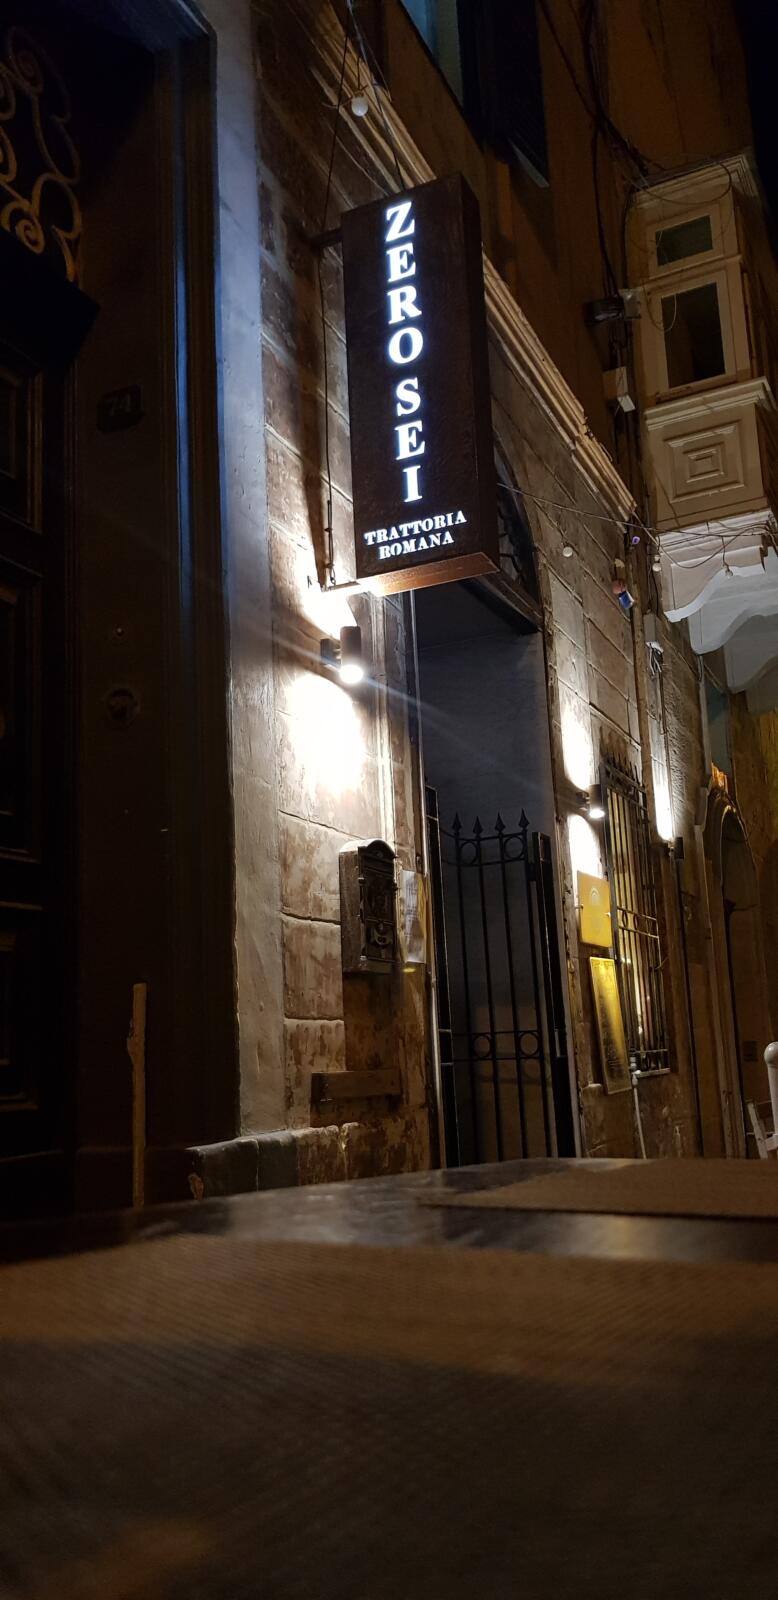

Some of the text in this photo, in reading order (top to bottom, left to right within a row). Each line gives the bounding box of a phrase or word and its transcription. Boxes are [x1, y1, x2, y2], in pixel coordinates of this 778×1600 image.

[384, 200, 426, 503] ZERO SEI
[364, 510, 467, 545] TRATTORIA
[379, 531, 454, 559] ROMANA
